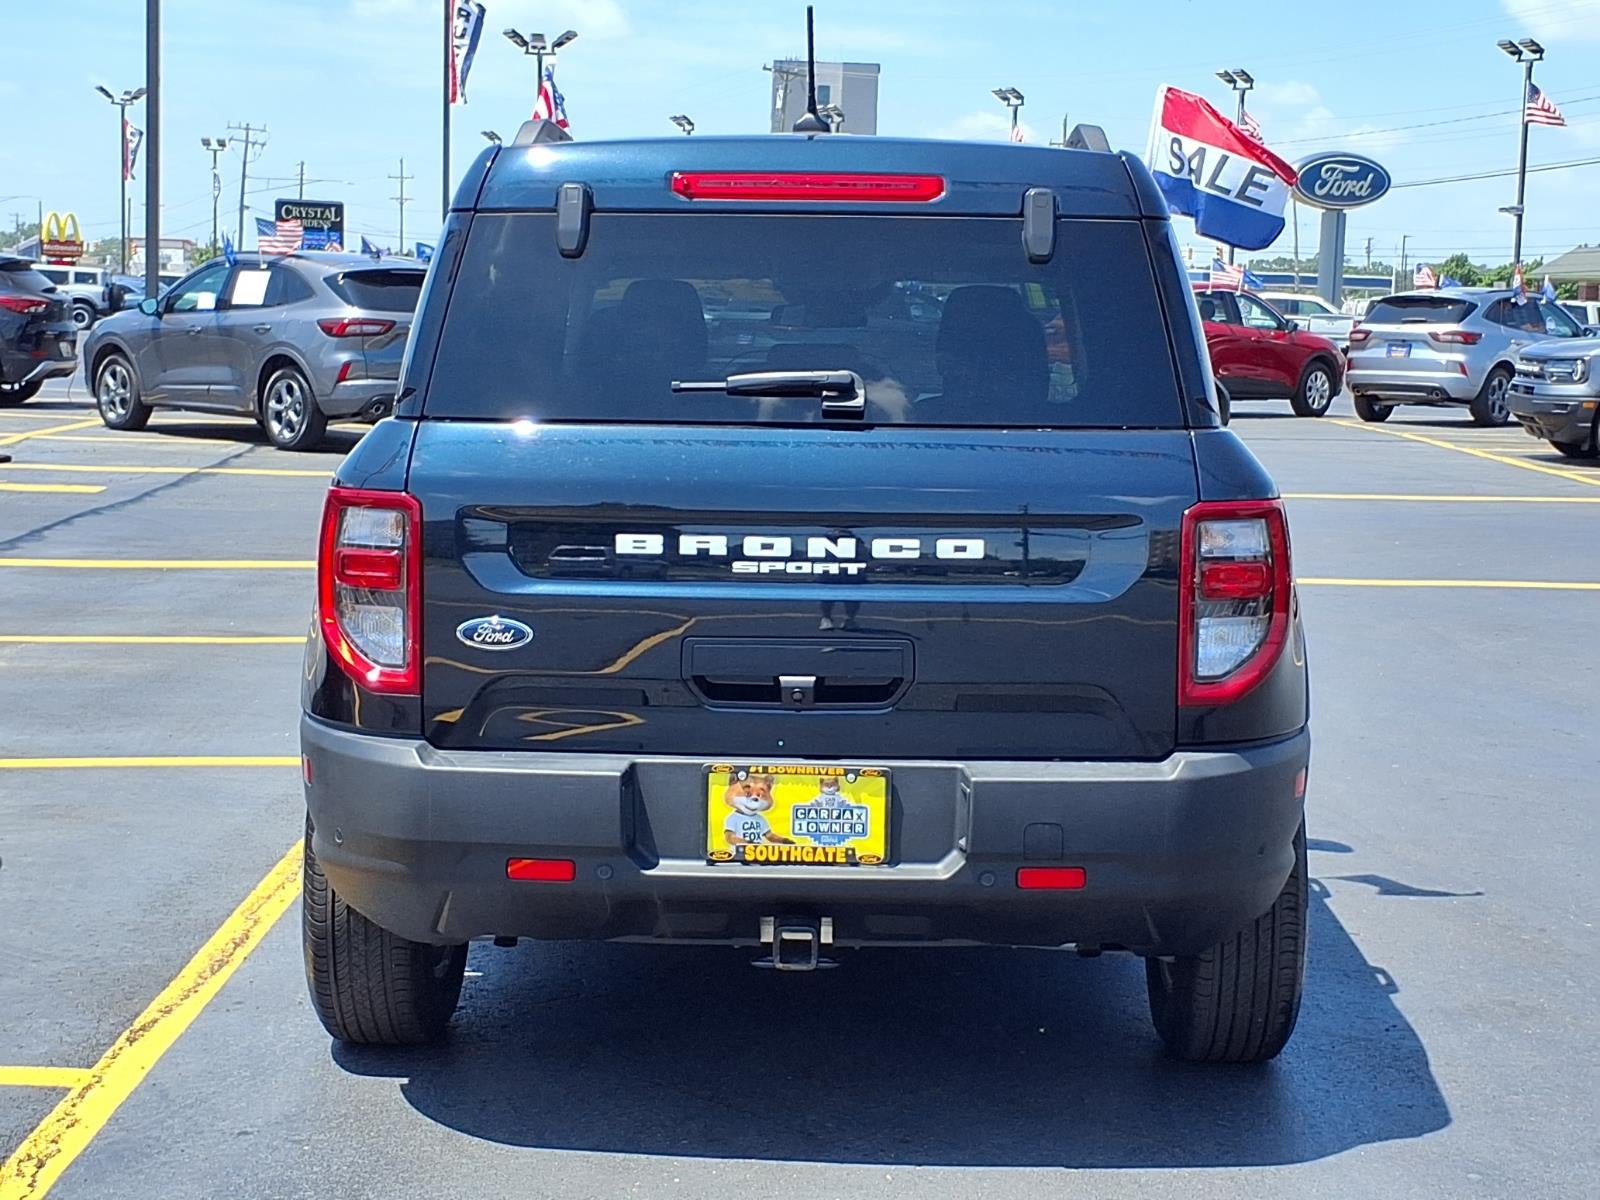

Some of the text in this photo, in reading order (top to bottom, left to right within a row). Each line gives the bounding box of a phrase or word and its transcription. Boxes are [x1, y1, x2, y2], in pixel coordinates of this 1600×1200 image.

[1169, 137, 1276, 207] SALE
[1314, 162, 1375, 198] Ford
[281, 205, 341, 222] CRYSTAL
[615, 533, 985, 559] BRONCO
[731, 561, 867, 575] SPORT
[473, 622, 515, 643] Ford
[767, 766, 845, 776] DOWNRIVER
[796, 808, 864, 822] CARFAX
[742, 821, 761, 831] CAR
[808, 823, 864, 834] OWNER
[743, 831, 762, 842] FOX
[744, 845, 847, 863] SOUTHGATE
